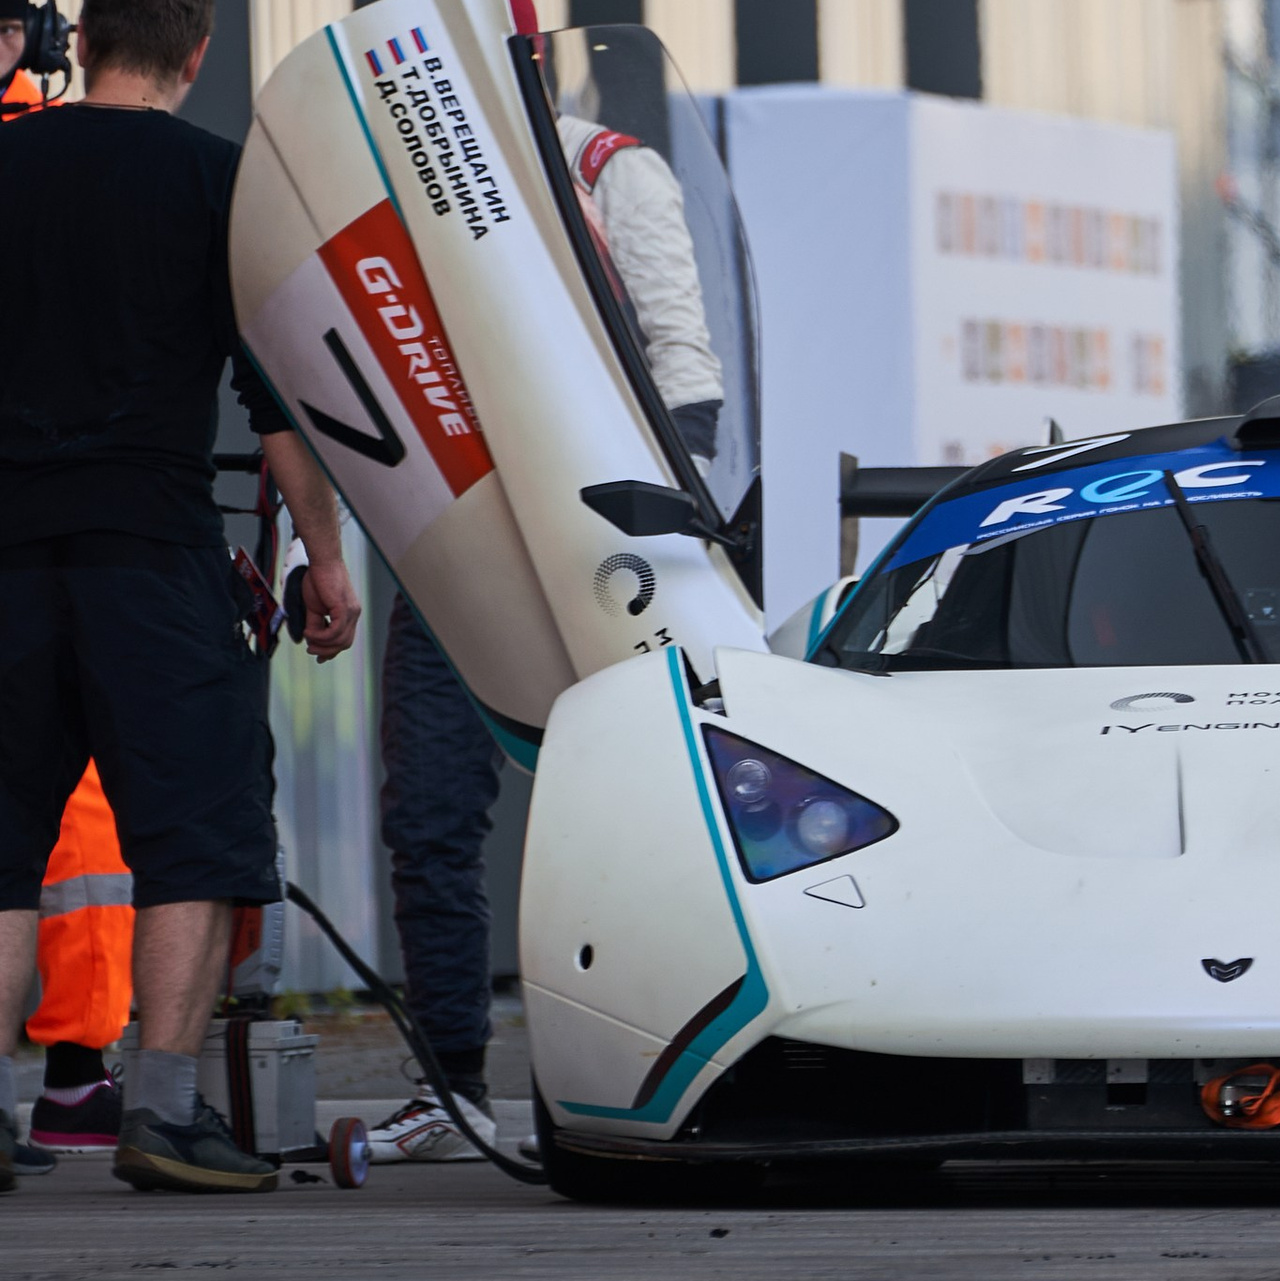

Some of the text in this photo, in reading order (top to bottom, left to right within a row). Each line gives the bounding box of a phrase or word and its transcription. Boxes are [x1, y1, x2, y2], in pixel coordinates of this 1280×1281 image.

[374, 79, 452, 217] Д.СОЛОВОВ
[401, 66, 489, 241] Т.ДОБРЫНИНА
[423, 57, 511, 223] В.ВЕРЕЩАГИН
[297, 327, 408, 468] 7
